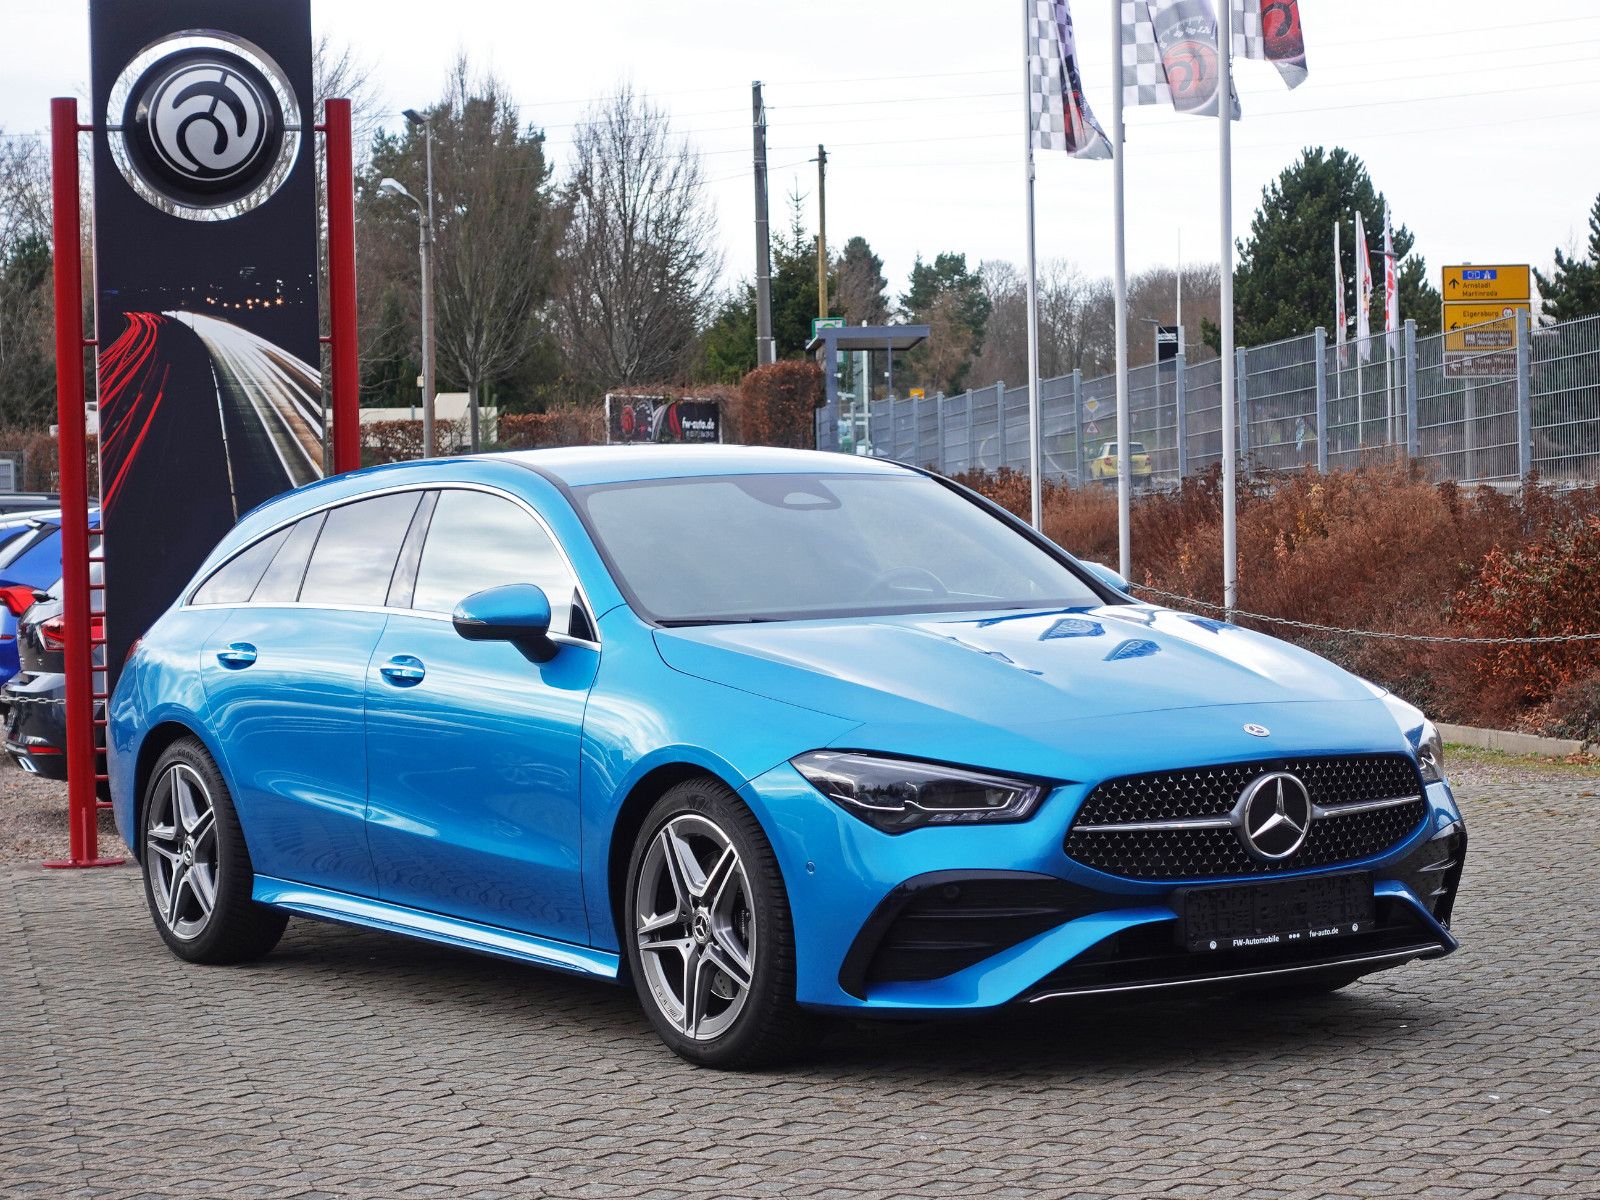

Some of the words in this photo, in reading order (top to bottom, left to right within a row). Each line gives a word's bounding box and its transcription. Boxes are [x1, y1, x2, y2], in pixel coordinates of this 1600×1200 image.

[1462, 310, 1499, 318] Elgersburg
[682, 416, 715, 430] fw-auto.de
[1232, 935, 1280, 947] FW-Automobile
[1309, 927, 1339, 938] fw-auto.de
